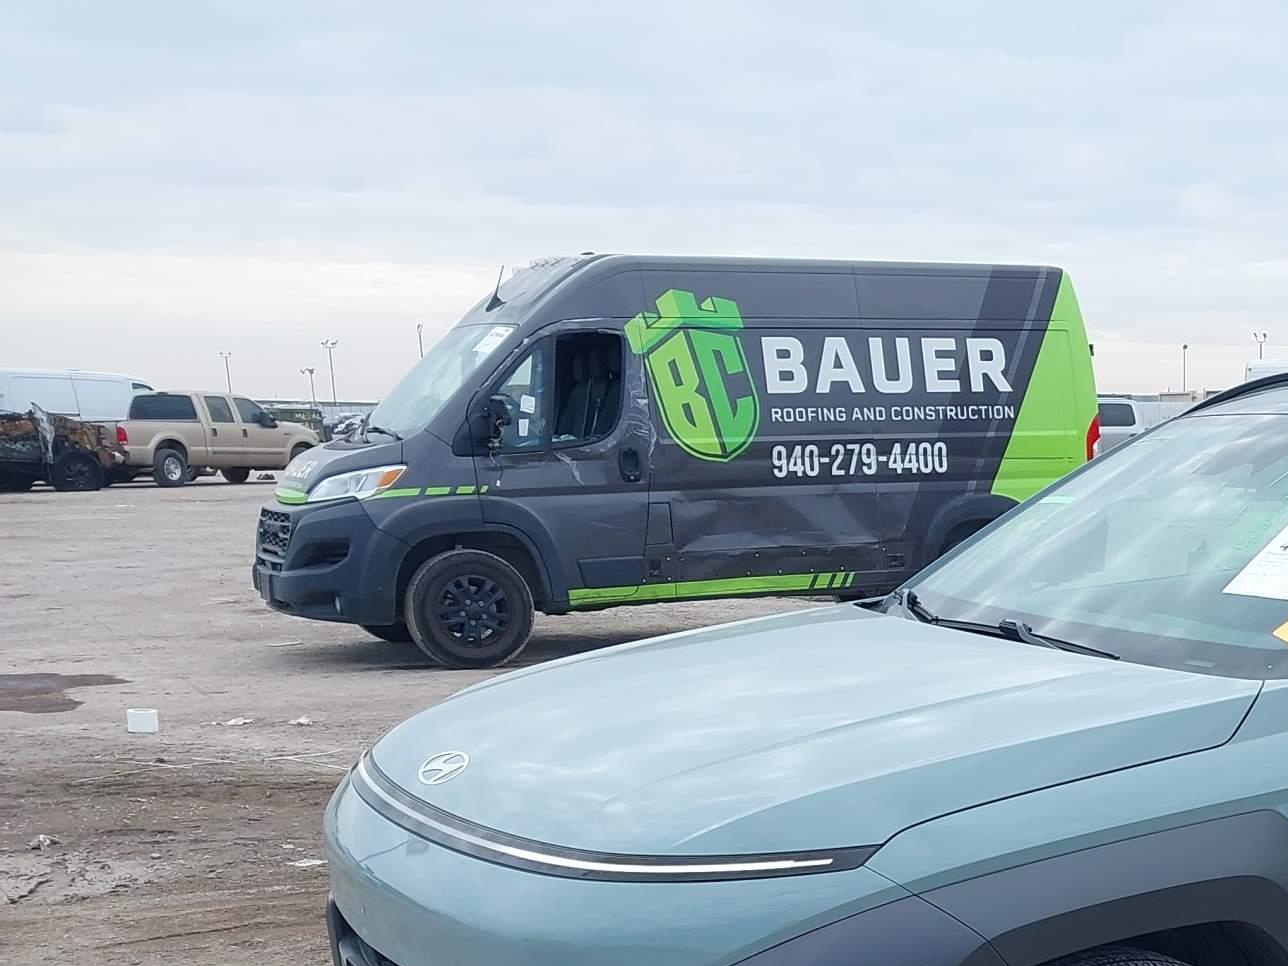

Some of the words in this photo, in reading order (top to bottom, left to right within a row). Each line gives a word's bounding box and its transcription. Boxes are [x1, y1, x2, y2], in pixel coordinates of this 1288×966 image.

[761, 336, 1014, 394] BAUER
[647, 328, 758, 456] BC
[771, 407, 847, 422] ROOFING
[852, 406, 886, 421] AND
[891, 405, 1015, 421] CONSTRUCTION
[772, 441, 948, 478] 940-279-4400
